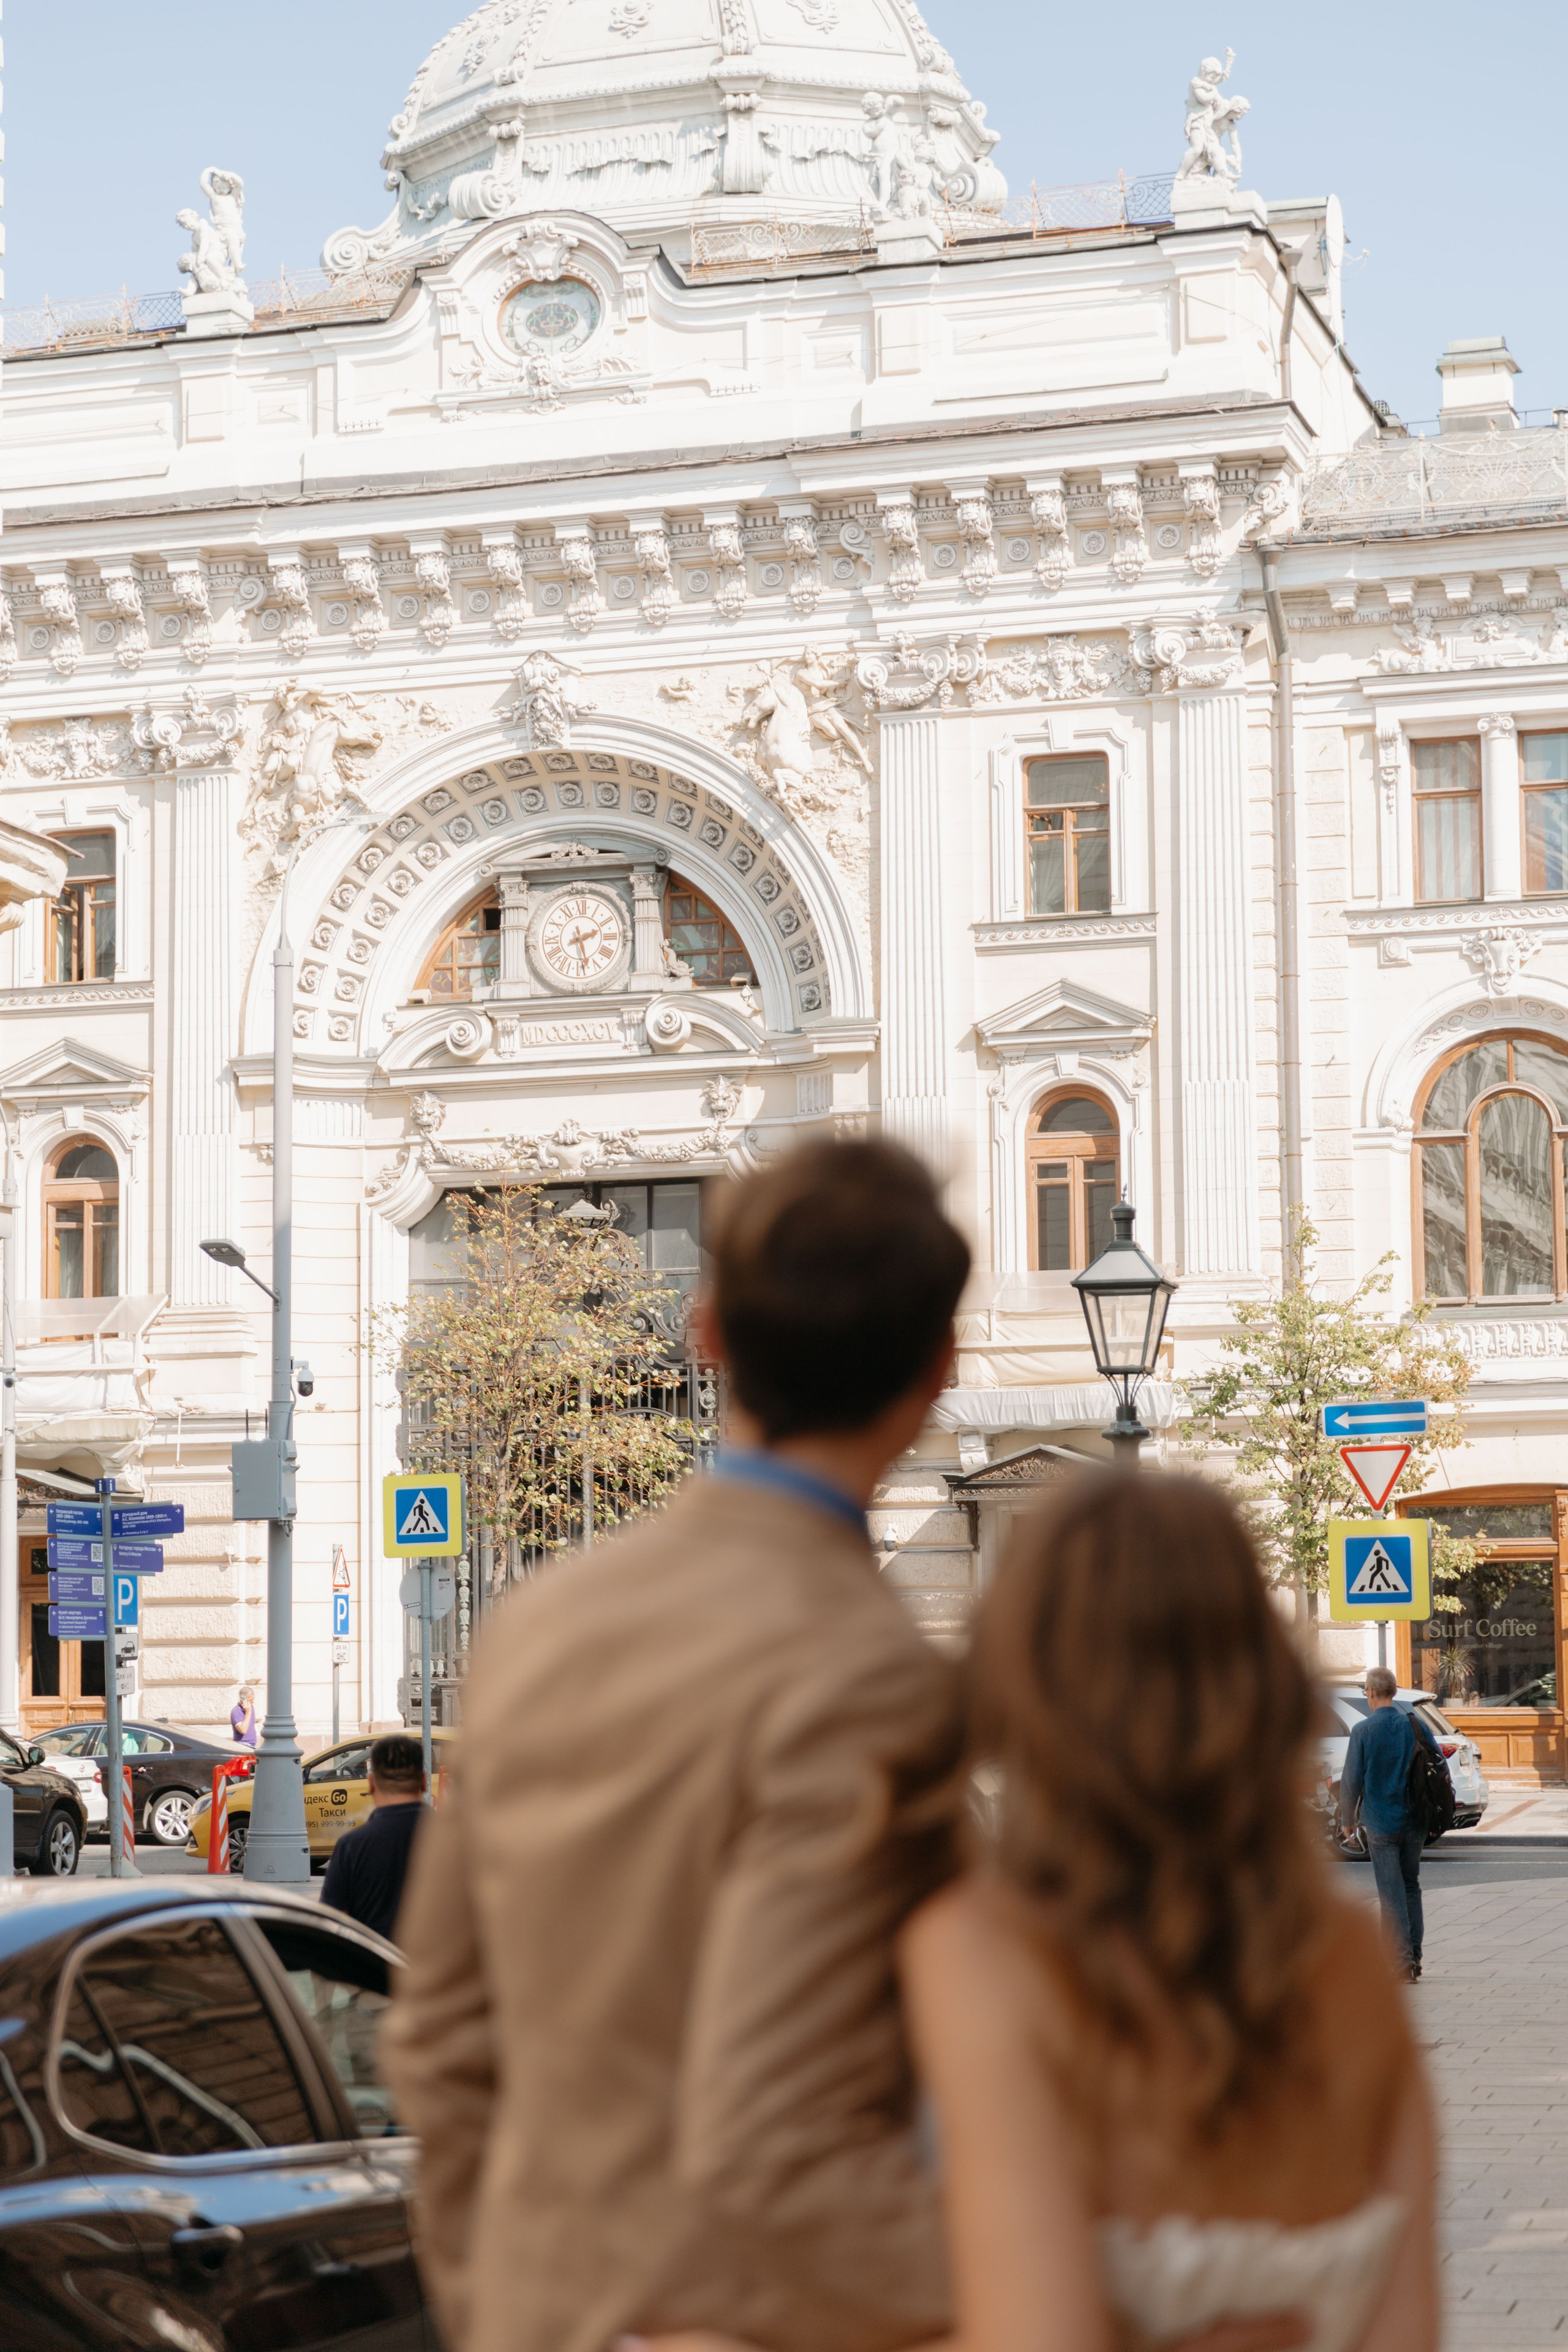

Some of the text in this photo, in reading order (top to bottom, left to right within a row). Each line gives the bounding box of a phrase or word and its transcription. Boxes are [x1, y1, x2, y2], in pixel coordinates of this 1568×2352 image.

[118, 1578, 134, 1620] P
[1428, 1619, 1537, 1638] Surf Coffee
[333, 1792, 346, 1803] Go
[319, 1807, 346, 1817] Такси
